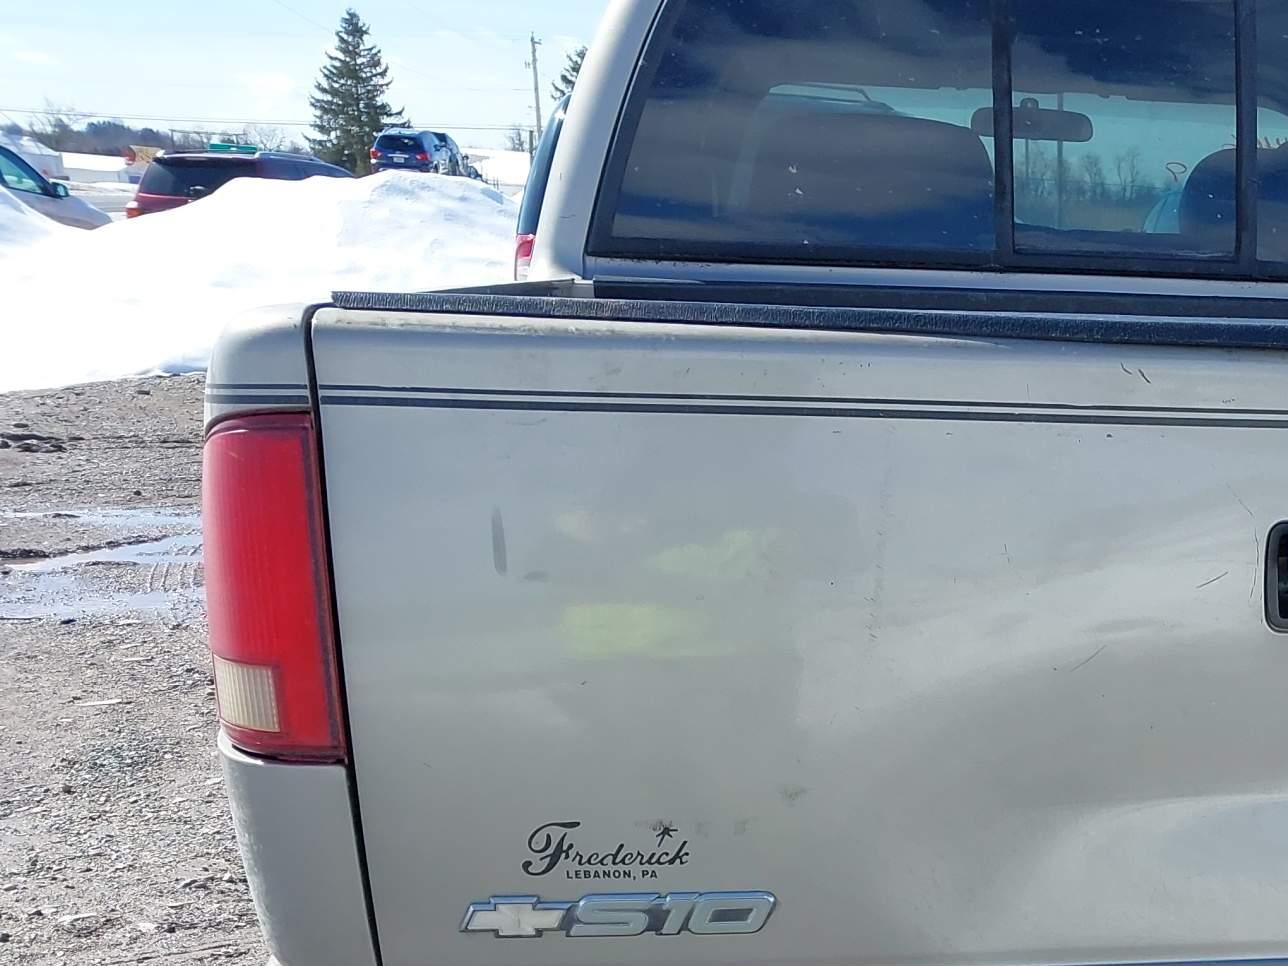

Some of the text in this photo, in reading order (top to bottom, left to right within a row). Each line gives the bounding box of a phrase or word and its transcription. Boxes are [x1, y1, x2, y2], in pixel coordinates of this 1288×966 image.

[521, 821, 690, 876] Frederick
[565, 869, 658, 881] LEBANON, PA
[564, 890, 778, 938] S10
